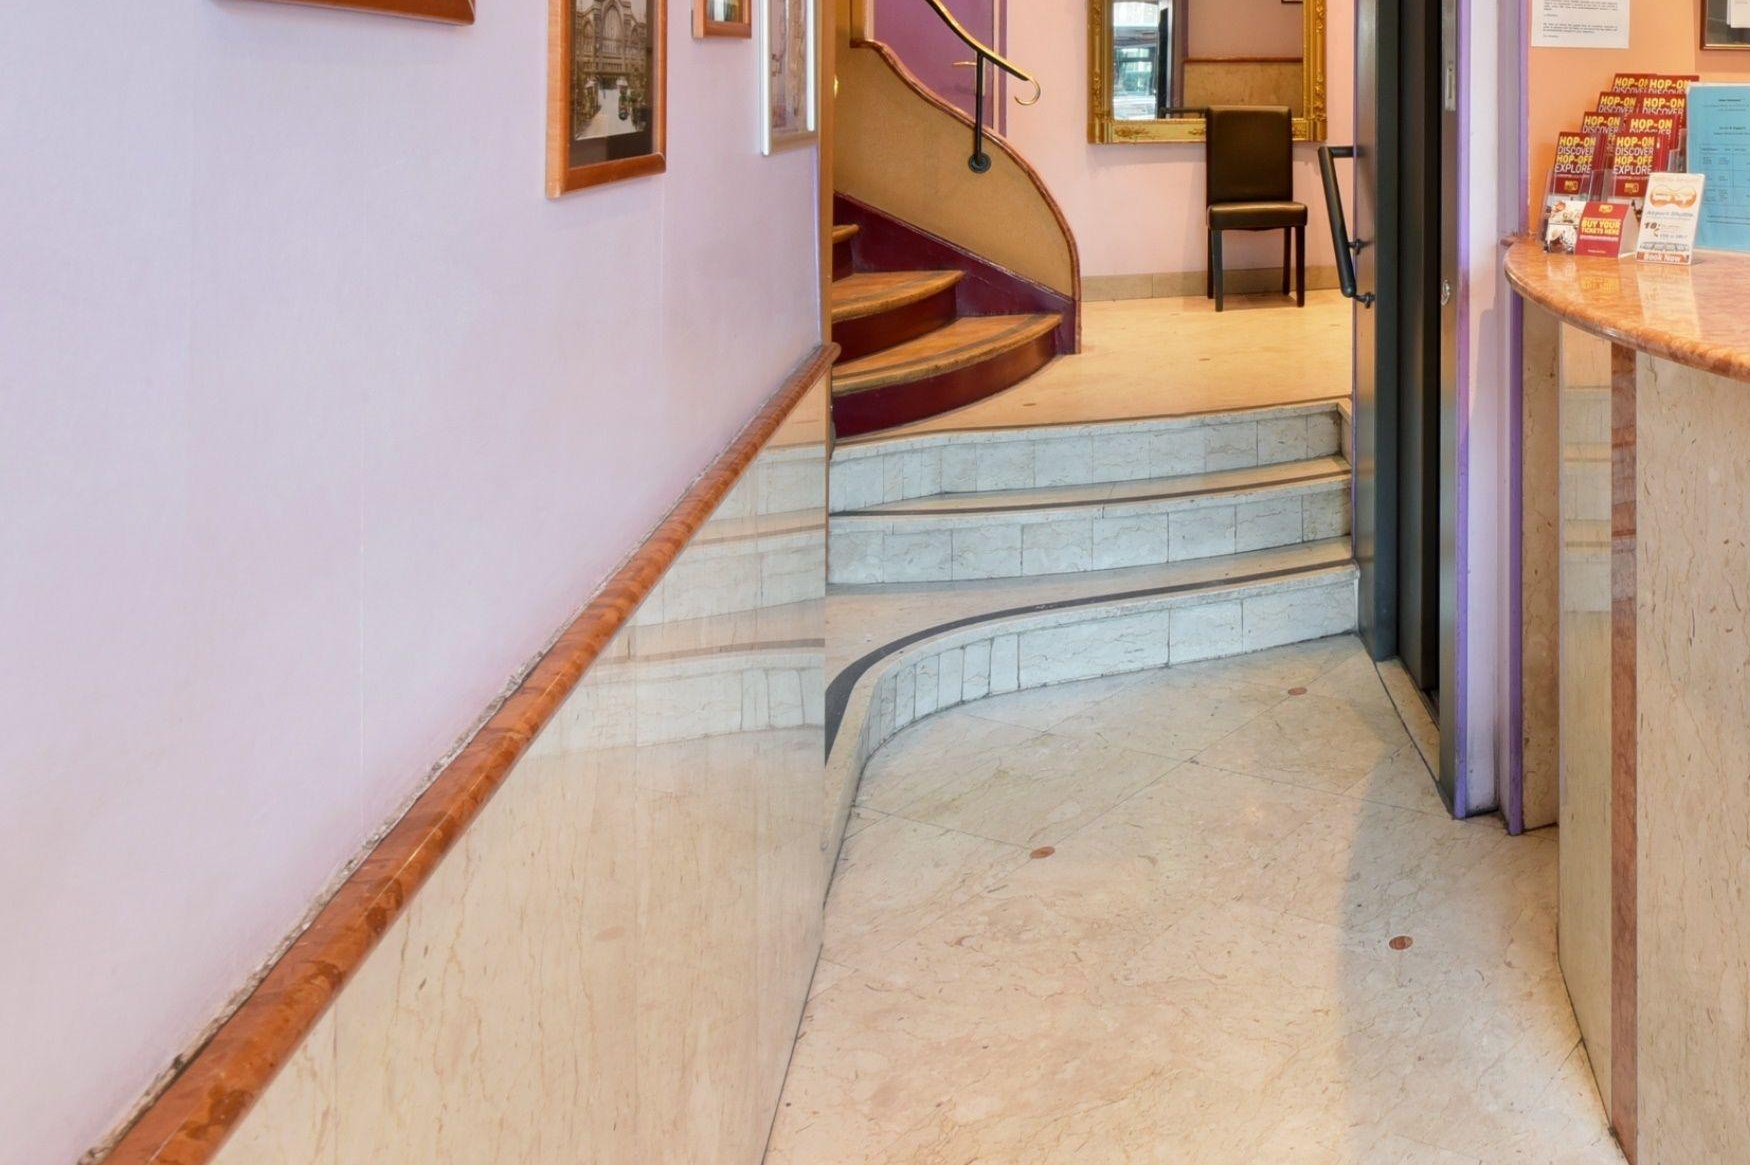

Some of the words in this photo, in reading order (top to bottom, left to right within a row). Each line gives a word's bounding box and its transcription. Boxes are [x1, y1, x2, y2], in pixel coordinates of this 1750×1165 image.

[1600, 95, 1637, 106] HOP-ON
[1643, 97, 1685, 108] HOP-ON
[1584, 116, 1621, 127] HOP-ON
[1630, 119, 1673, 130] HOP-ON
[1559, 136, 1597, 147] HOP-ON
[1616, 137, 1656, 148] HOP-ON
[1557, 146, 1595, 156] DISCOVER
[1615, 147, 1655, 157] DISCOVER
[1556, 155, 1594, 165] HOP-OFF
[1614, 156, 1654, 166] HOP-OFF
[1555, 164, 1592, 174] EXPLORE
[1613, 164, 1653, 175] EXPLORE
[1581, 219, 1598, 228] BUY
[1599, 220, 1621, 229] YOUR
